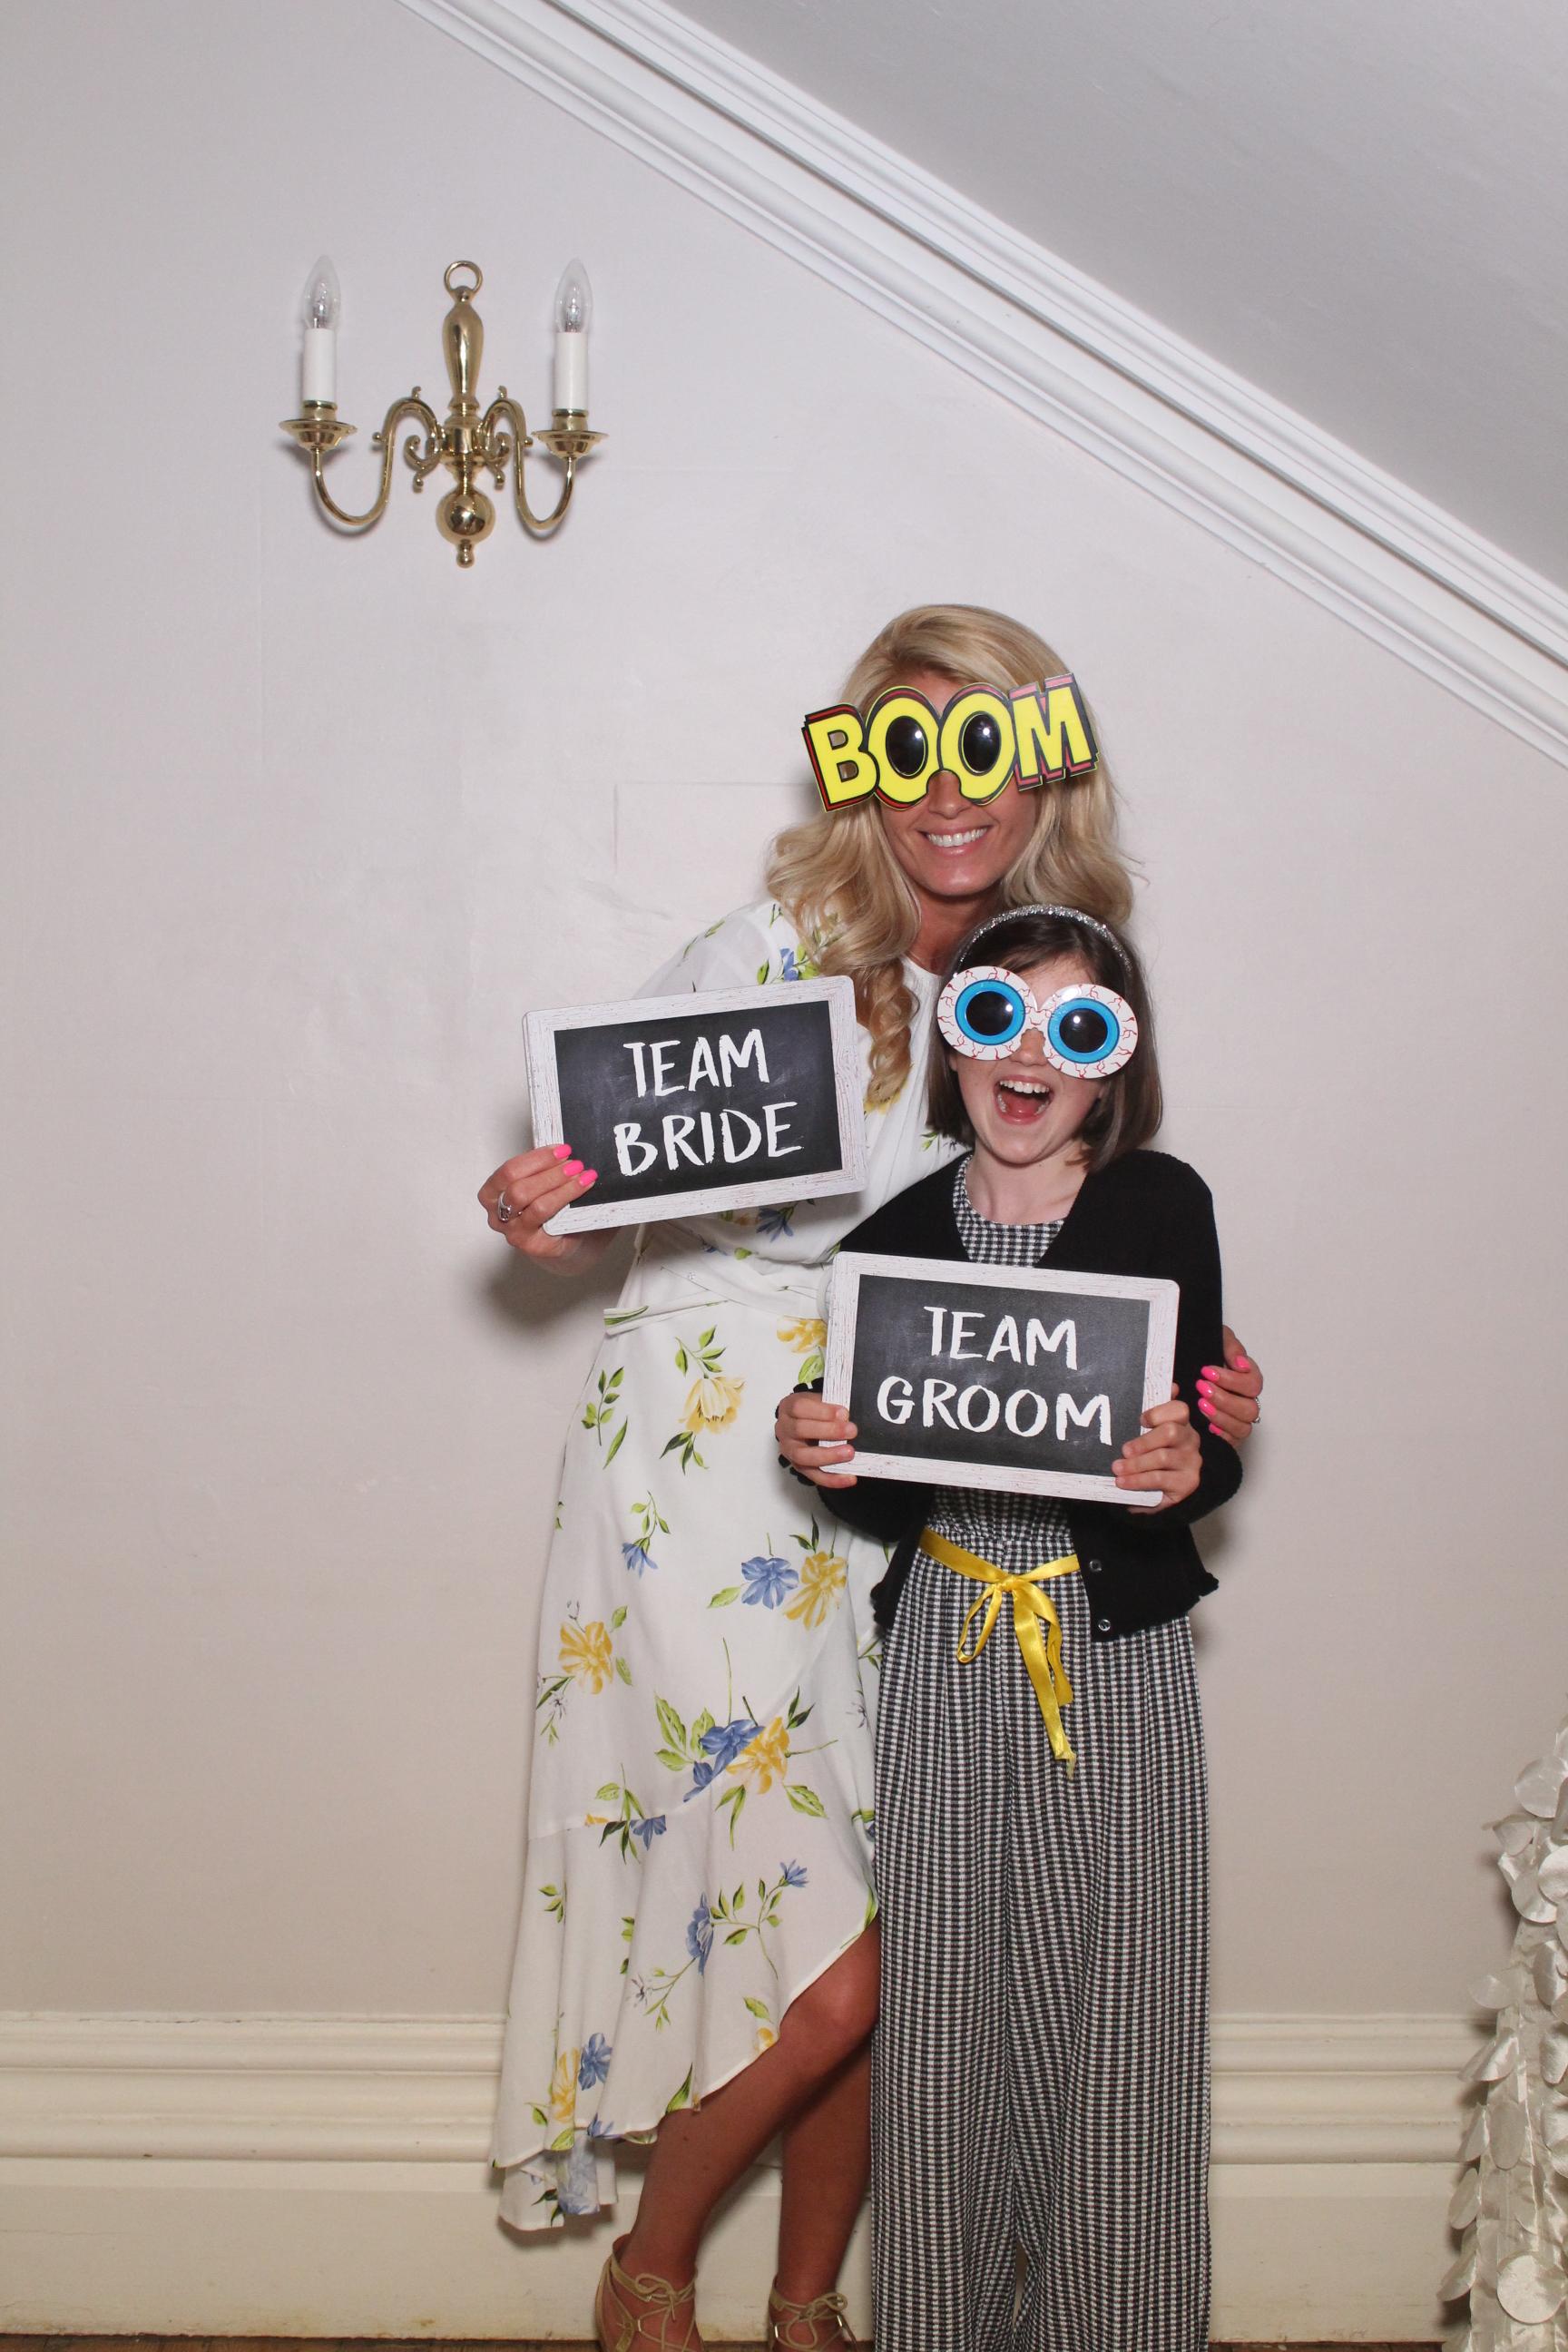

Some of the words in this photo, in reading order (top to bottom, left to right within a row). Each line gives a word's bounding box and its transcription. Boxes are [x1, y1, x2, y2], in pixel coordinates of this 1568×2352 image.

[803, 674, 1098, 811] BOOM
[623, 1028, 769, 1097] TEAM
[613, 1102, 804, 1176] BRIDE
[923, 1306, 1077, 1370] TEAM
[877, 1376, 1112, 1446] GROOM
